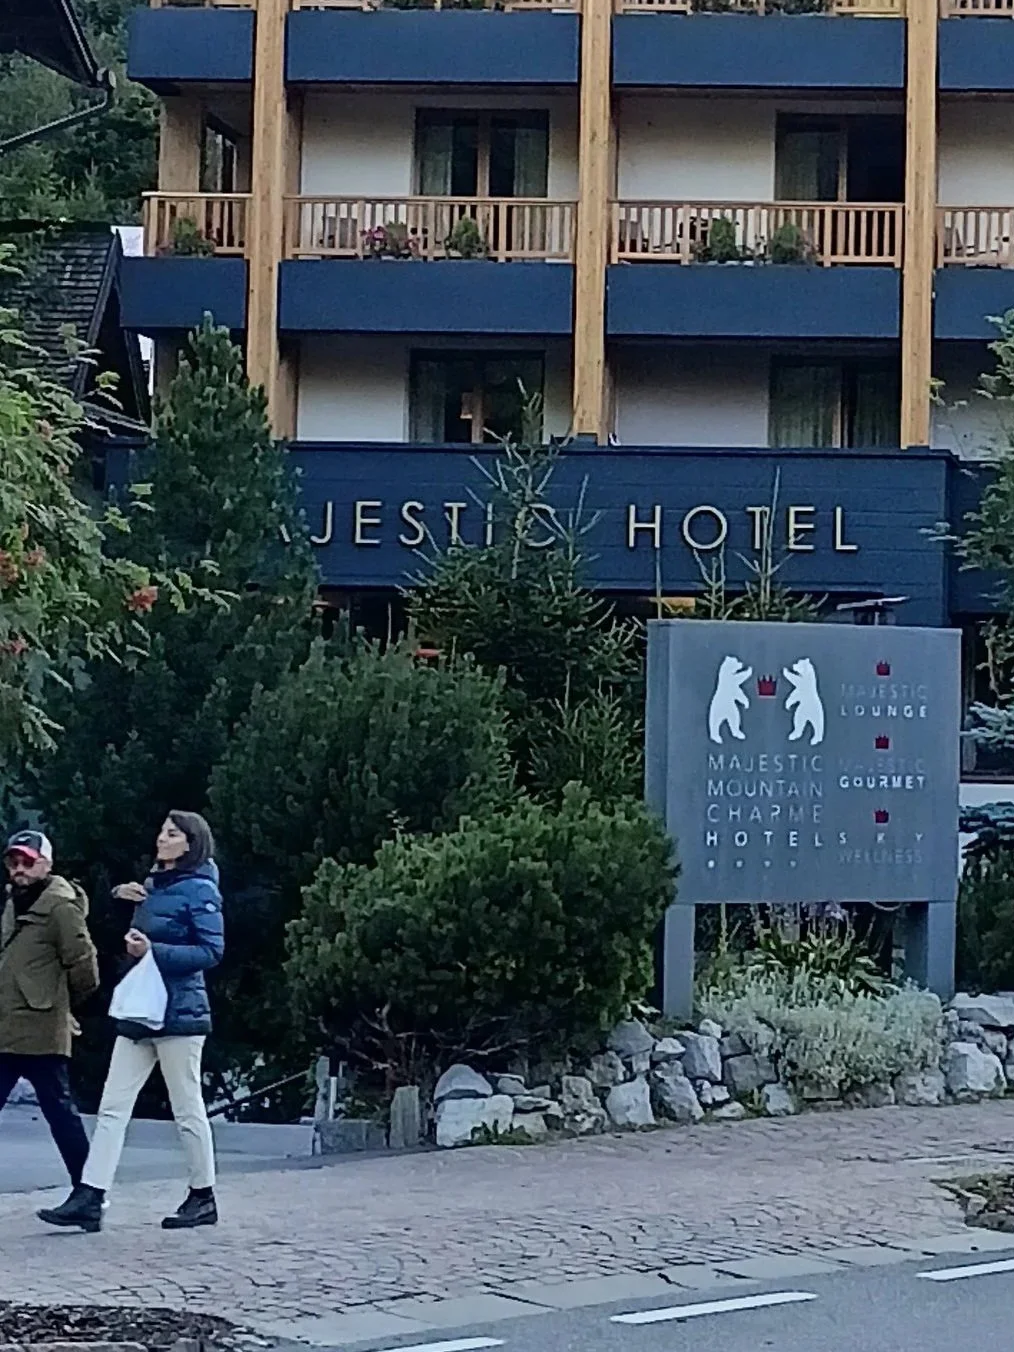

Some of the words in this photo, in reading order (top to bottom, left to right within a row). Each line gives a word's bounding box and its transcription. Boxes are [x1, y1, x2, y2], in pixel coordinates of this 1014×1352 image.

[279, 500, 557, 547] JESTIC
[628, 504, 859, 551] HOTEL
[841, 704, 927, 718] LOUNGE
[708, 754, 823, 773] MAJESTIC
[707, 779, 823, 798] MOUNTAIN
[839, 775, 926, 789] GOURMET
[707, 804, 823, 824] CHARME
[706, 831, 825, 848] HOTEL
